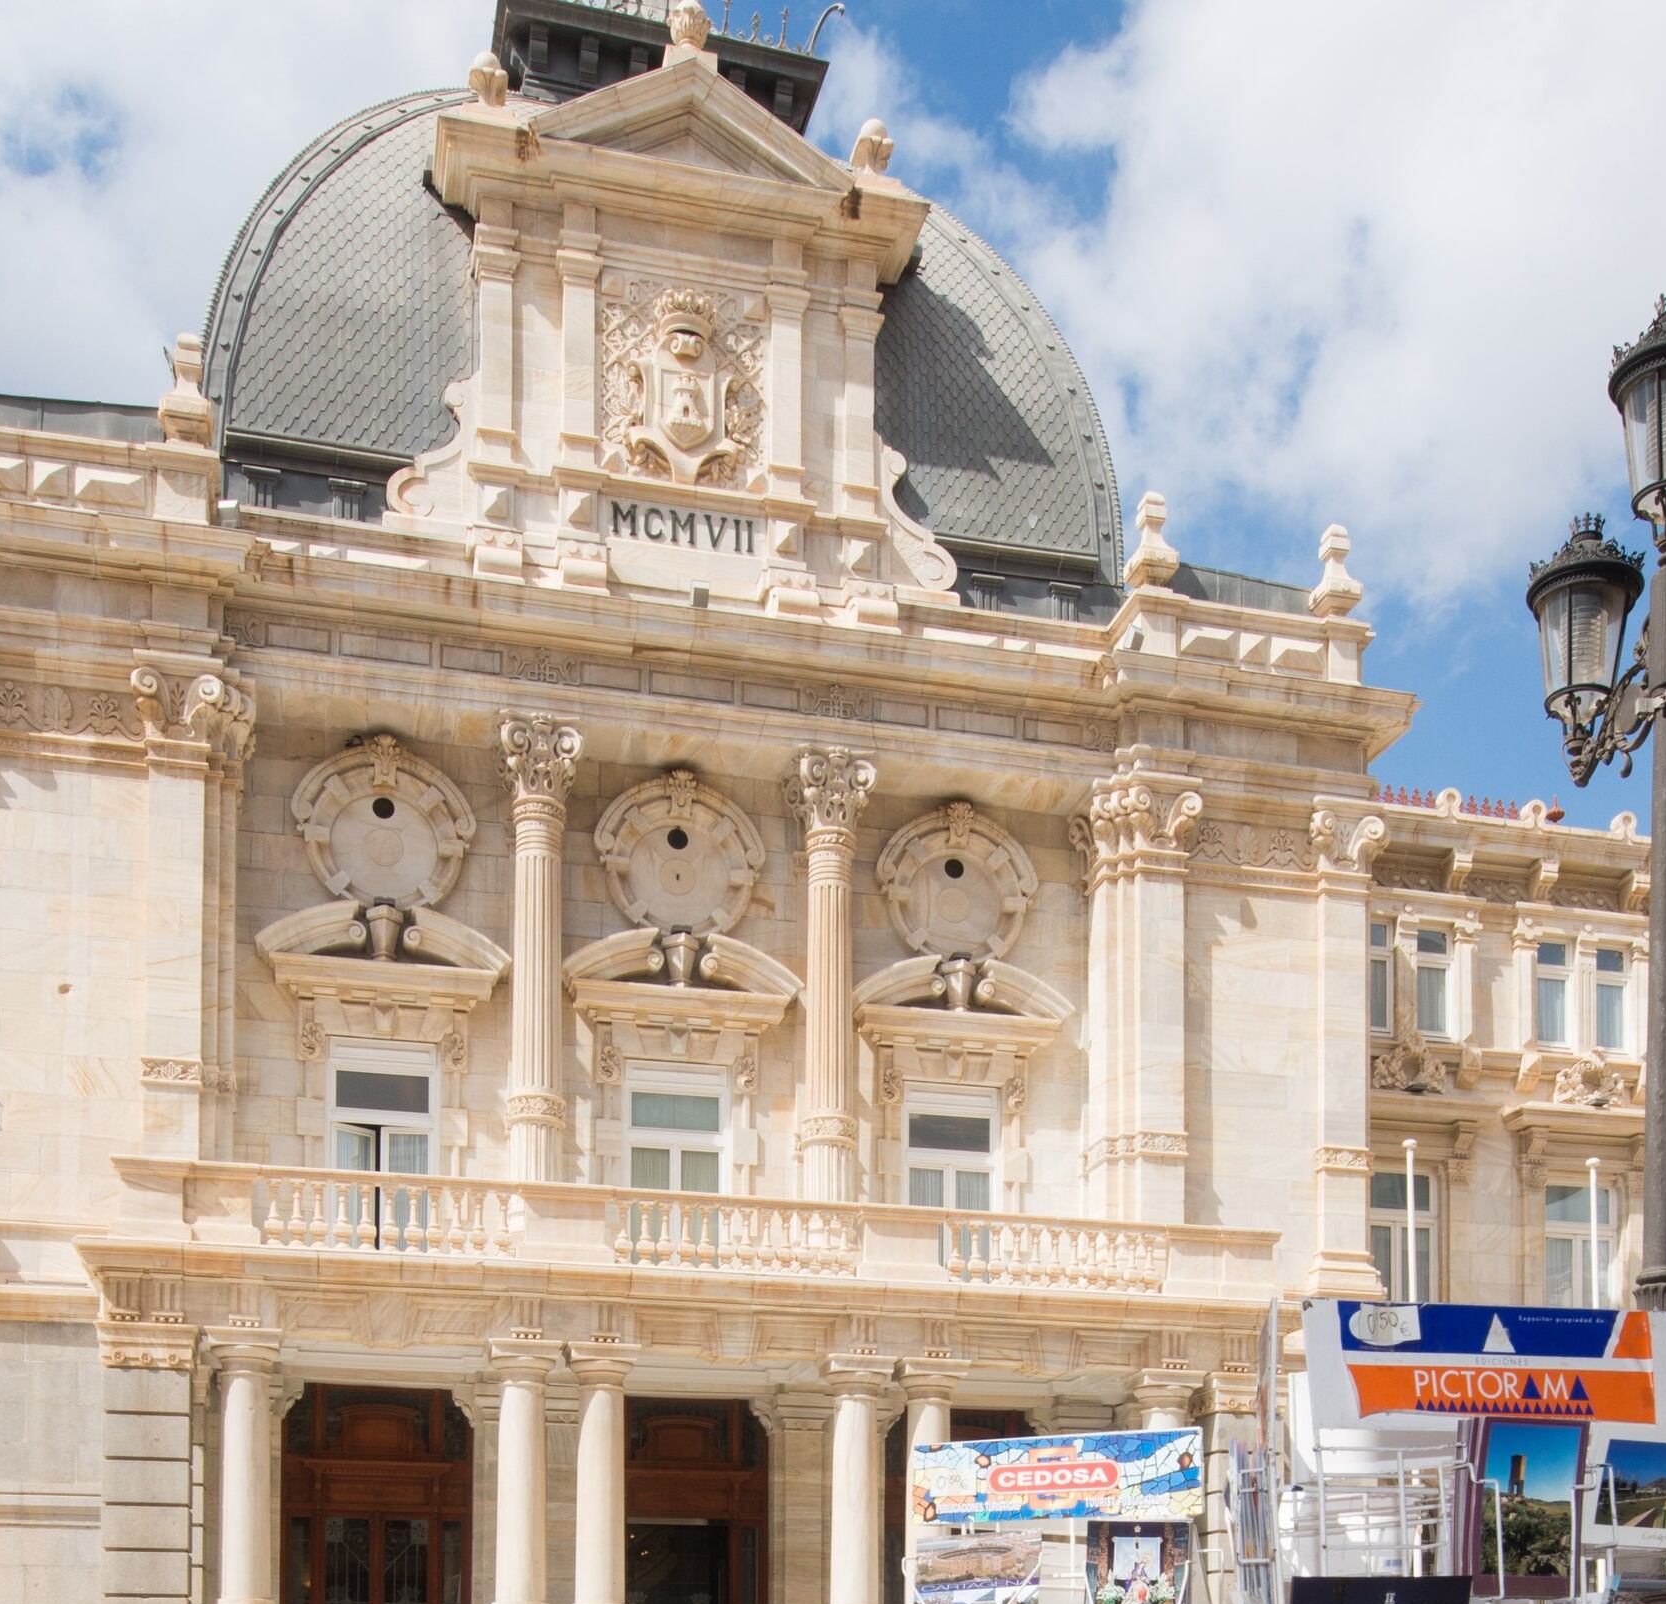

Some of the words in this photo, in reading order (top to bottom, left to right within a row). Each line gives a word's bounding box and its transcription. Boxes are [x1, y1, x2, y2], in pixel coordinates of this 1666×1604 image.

[610, 501, 754, 553] MCMVII
[1475, 1358, 1529, 1367] EDICIONES
[1414, 1370, 1589, 1401] PICTORAMA
[997, 1467, 1109, 1488] CEDOSA
